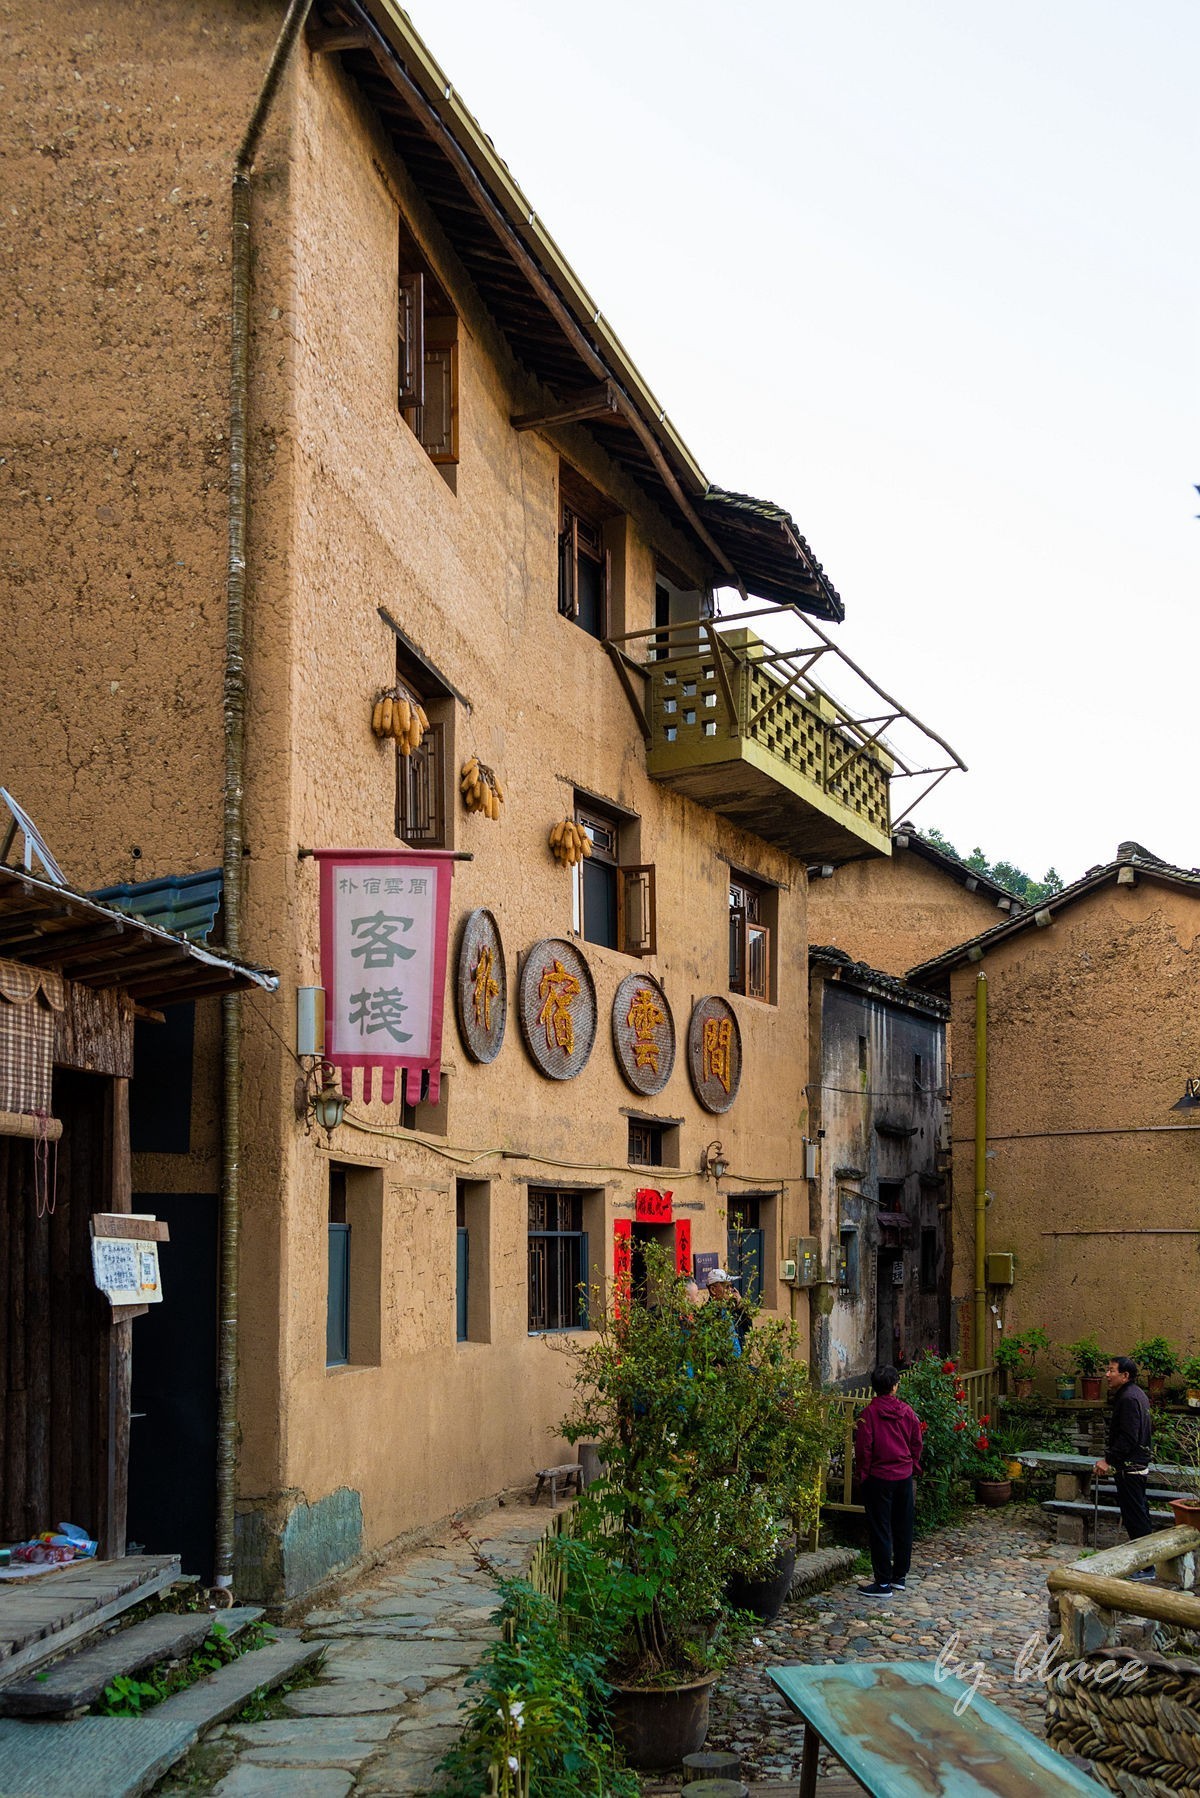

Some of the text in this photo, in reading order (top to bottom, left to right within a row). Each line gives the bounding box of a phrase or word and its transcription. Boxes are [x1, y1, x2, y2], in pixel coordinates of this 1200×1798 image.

[339, 877, 428, 896] 朴宿雲間
[348, 910, 417, 1043] 客棧
